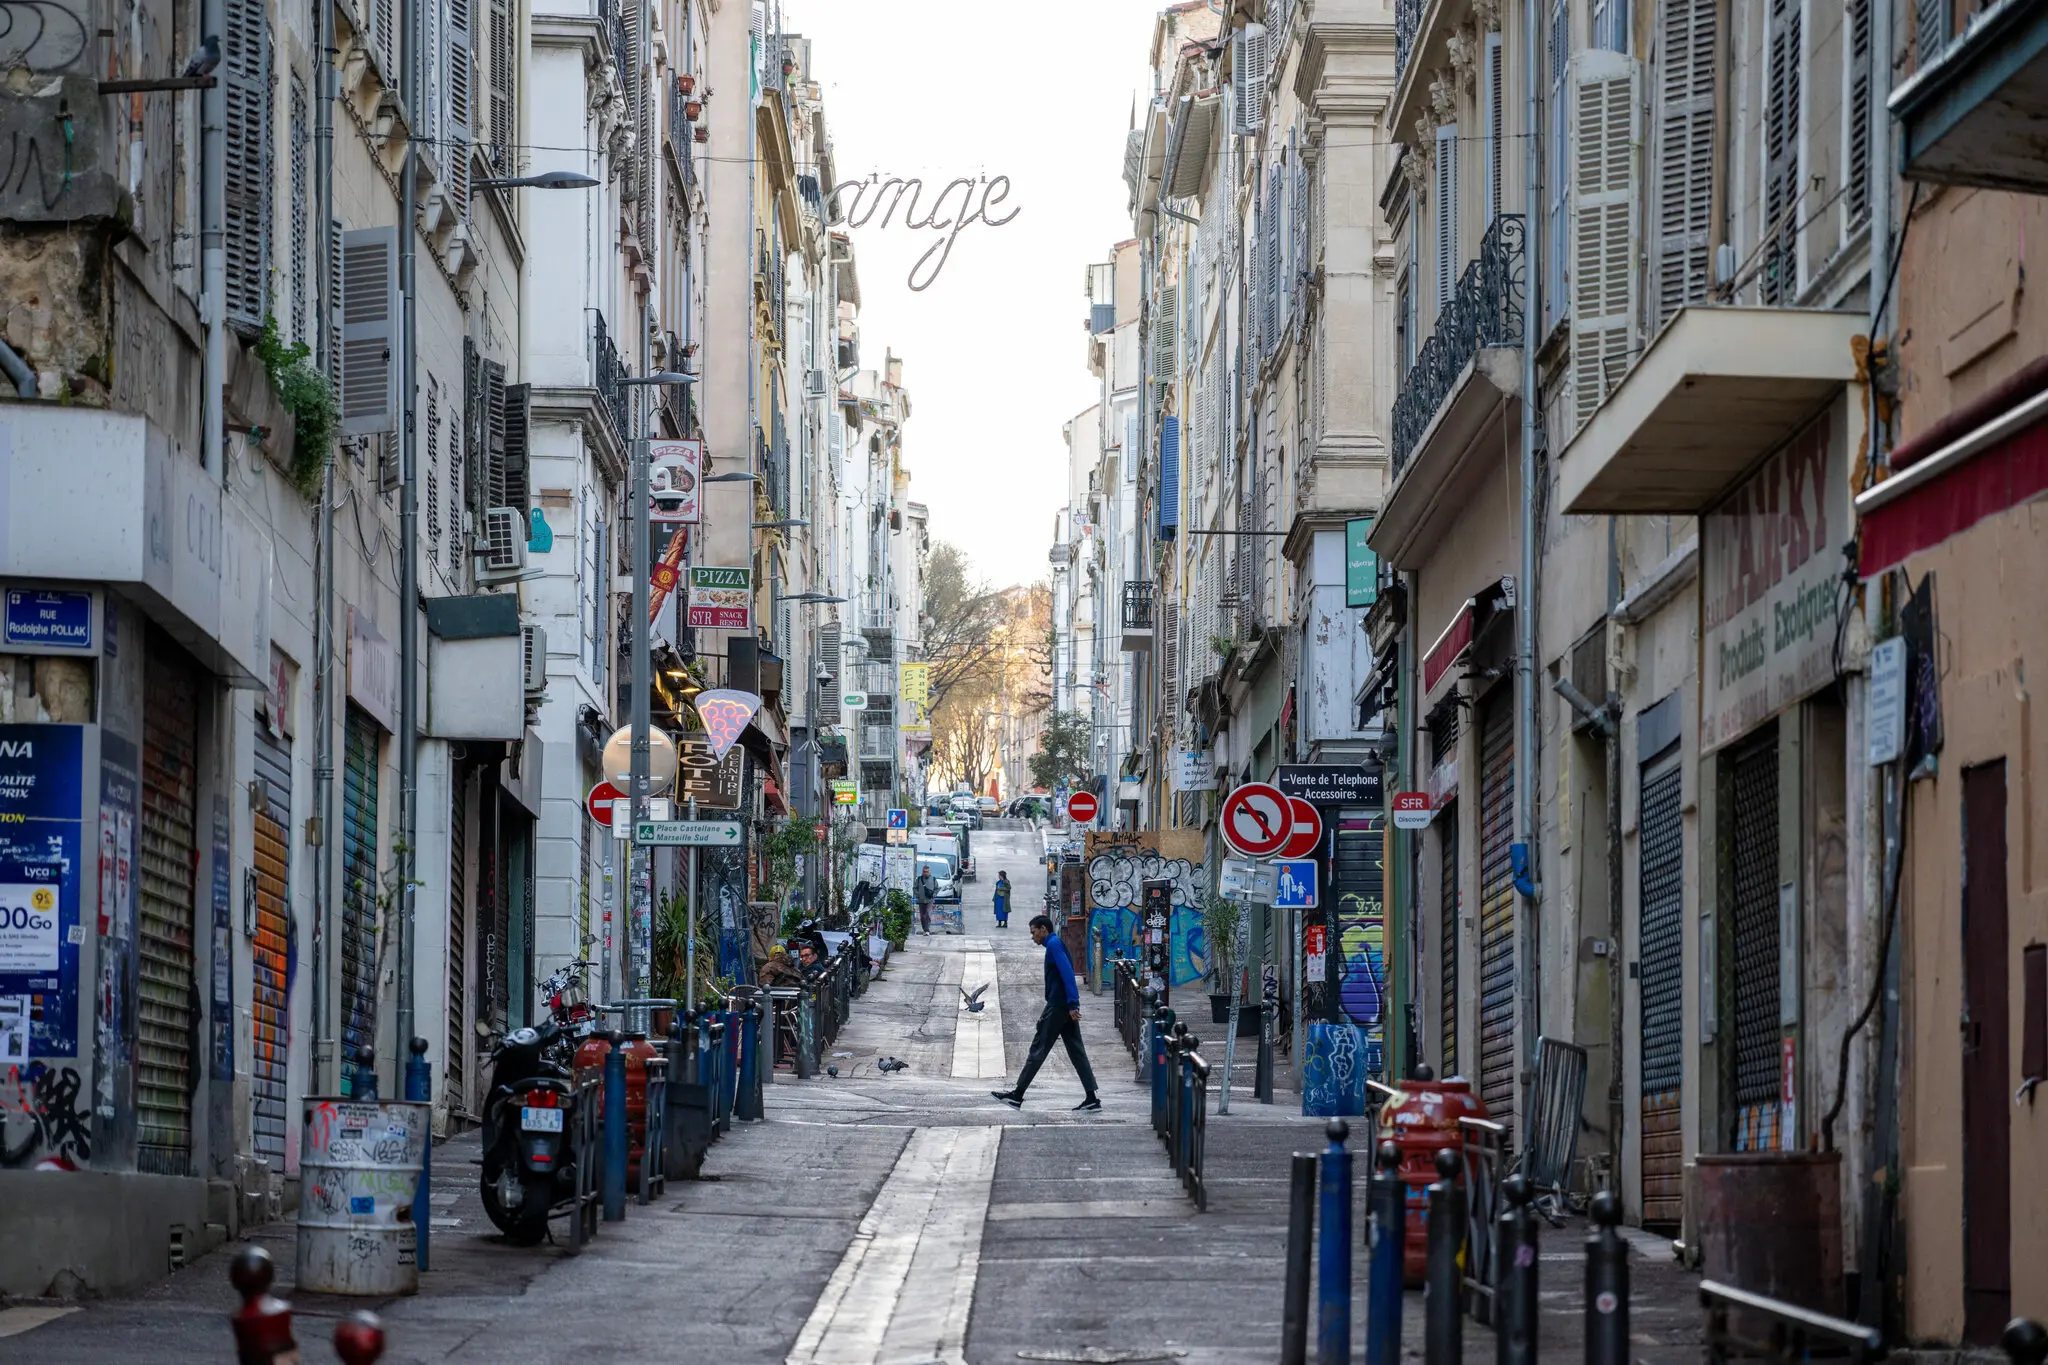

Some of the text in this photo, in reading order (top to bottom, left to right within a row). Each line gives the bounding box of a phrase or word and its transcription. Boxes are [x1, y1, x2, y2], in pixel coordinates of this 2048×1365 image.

[654, 446, 691, 457] PIZZA
[696, 570, 746, 585] PIZZA
[40, 609, 57, 620] RUE
[691, 610, 712, 625] SYR
[719, 611, 743, 619] SNACK
[9, 621, 86, 637] Rodolphe POLLAK
[1719, 618, 1765, 691] Produits
[1774, 573, 1837, 654] Exotiques
[727, 753, 740, 796] CENTRE
[1318, 773, 1329, 785] de
[1332, 773, 1379, 788] Telephone
[1304, 788, 1357, 799] Accessoires
[1401, 798, 1423, 809] SFR
[656, 824, 721, 832] Place Castellane
[24, 866, 50, 879] Lyca
